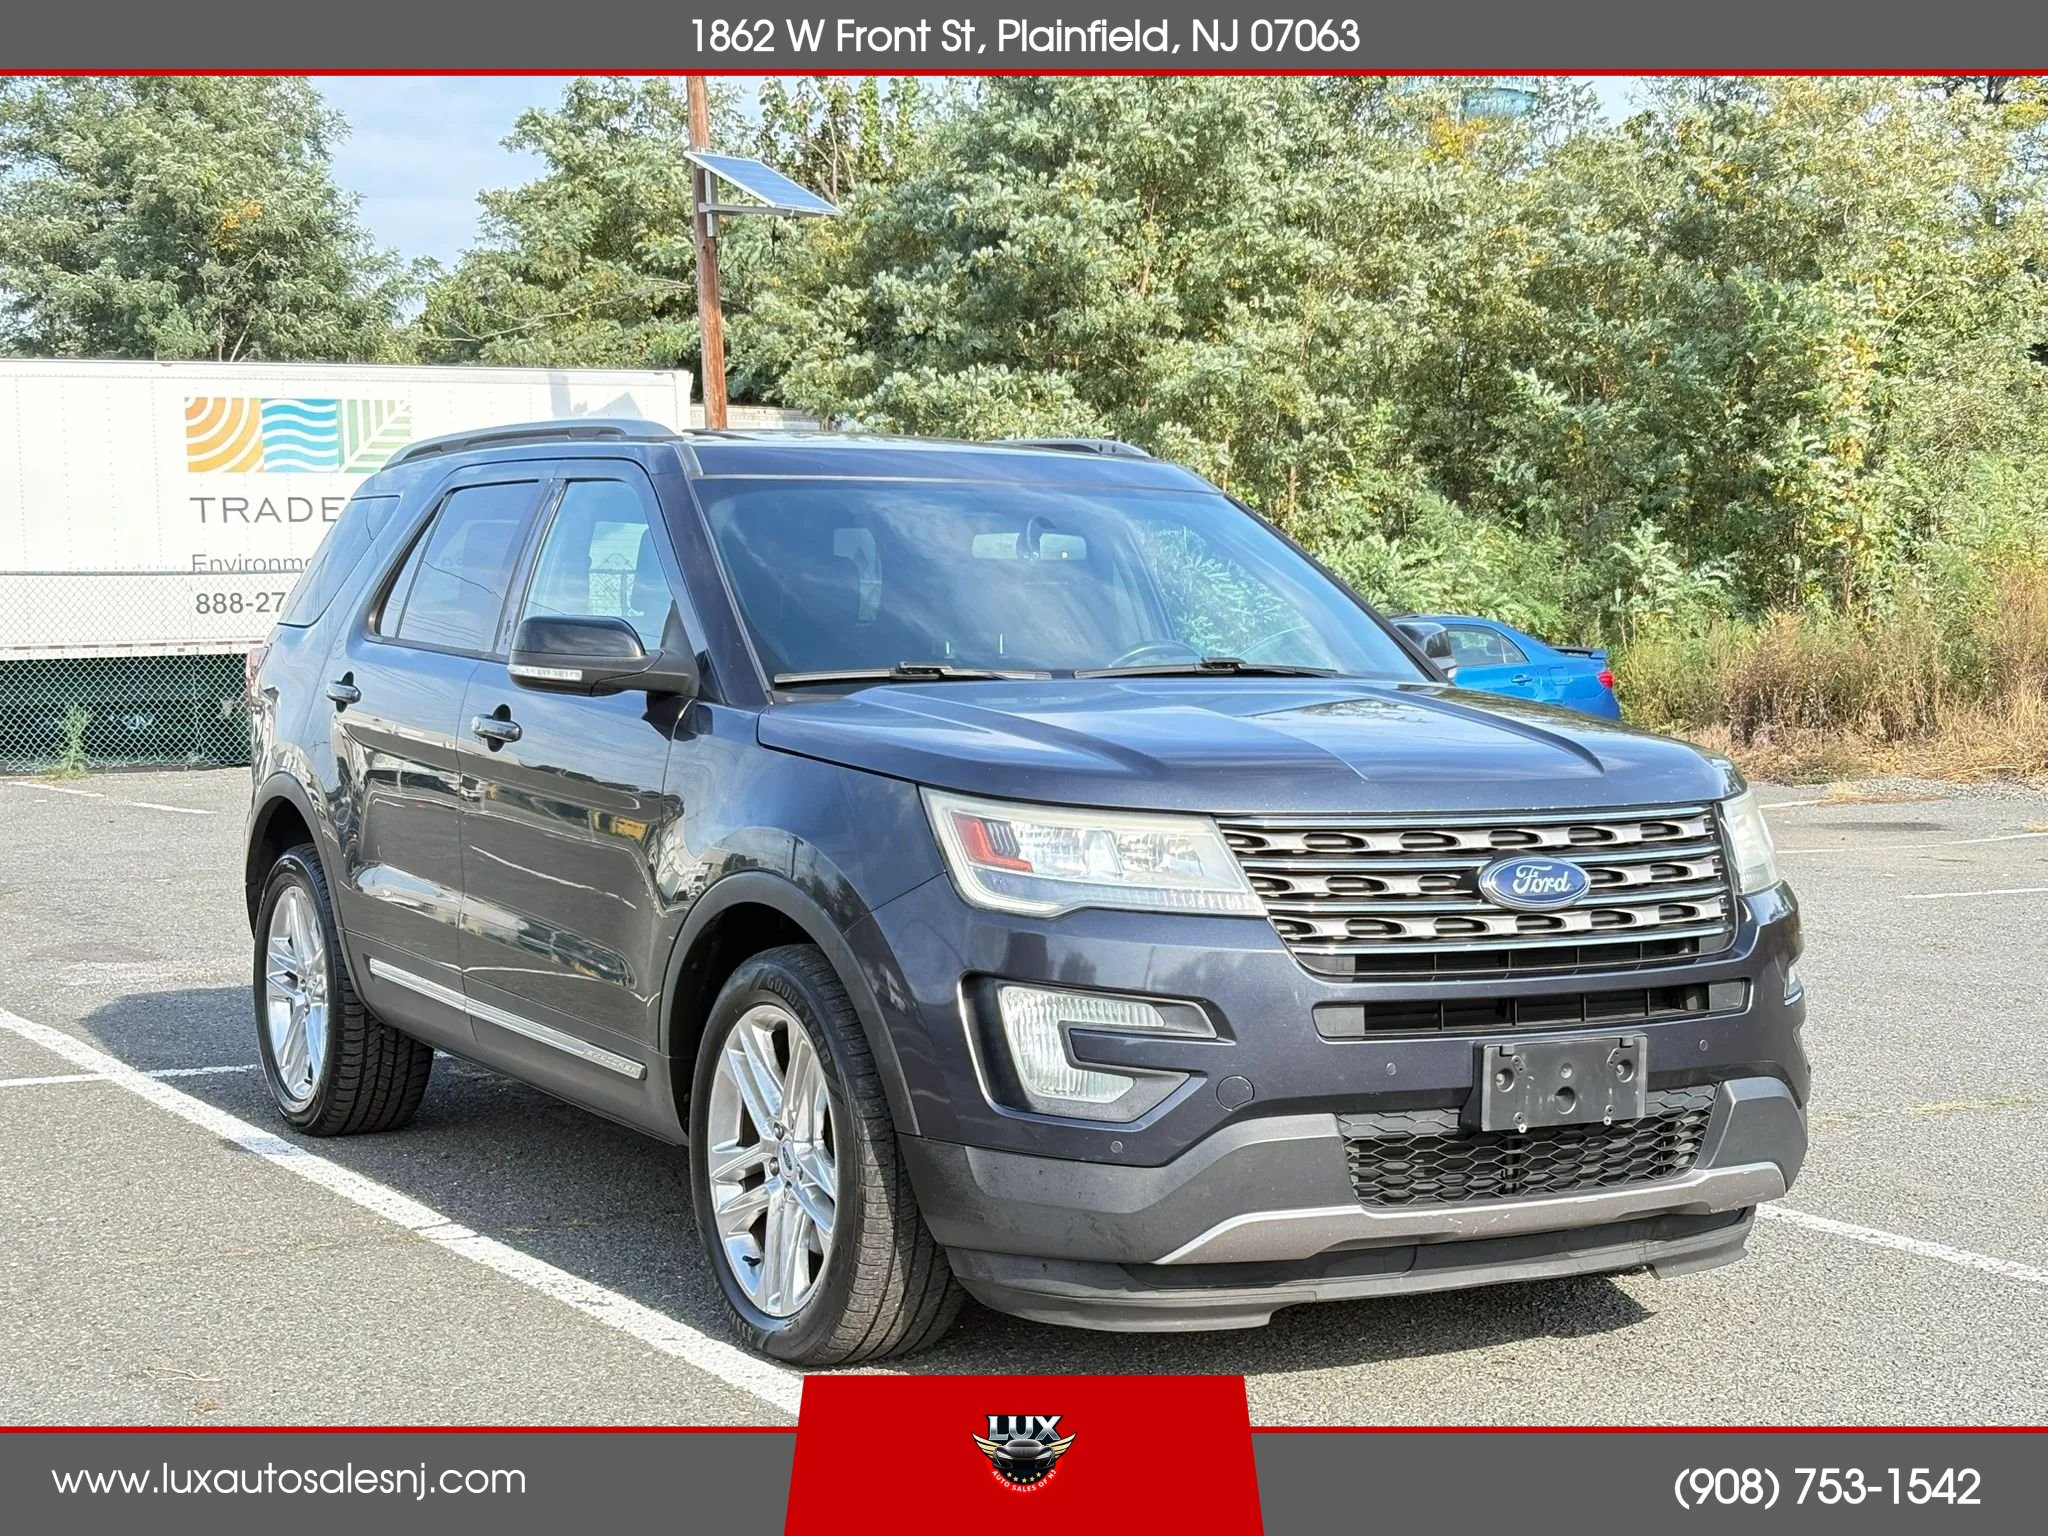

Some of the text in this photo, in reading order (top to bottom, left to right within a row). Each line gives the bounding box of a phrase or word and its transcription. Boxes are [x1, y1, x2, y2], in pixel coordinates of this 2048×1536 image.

[189, 496, 346, 524] TRADE
[195, 591, 287, 615] 888-27
[1512, 865, 1572, 894] Ford
